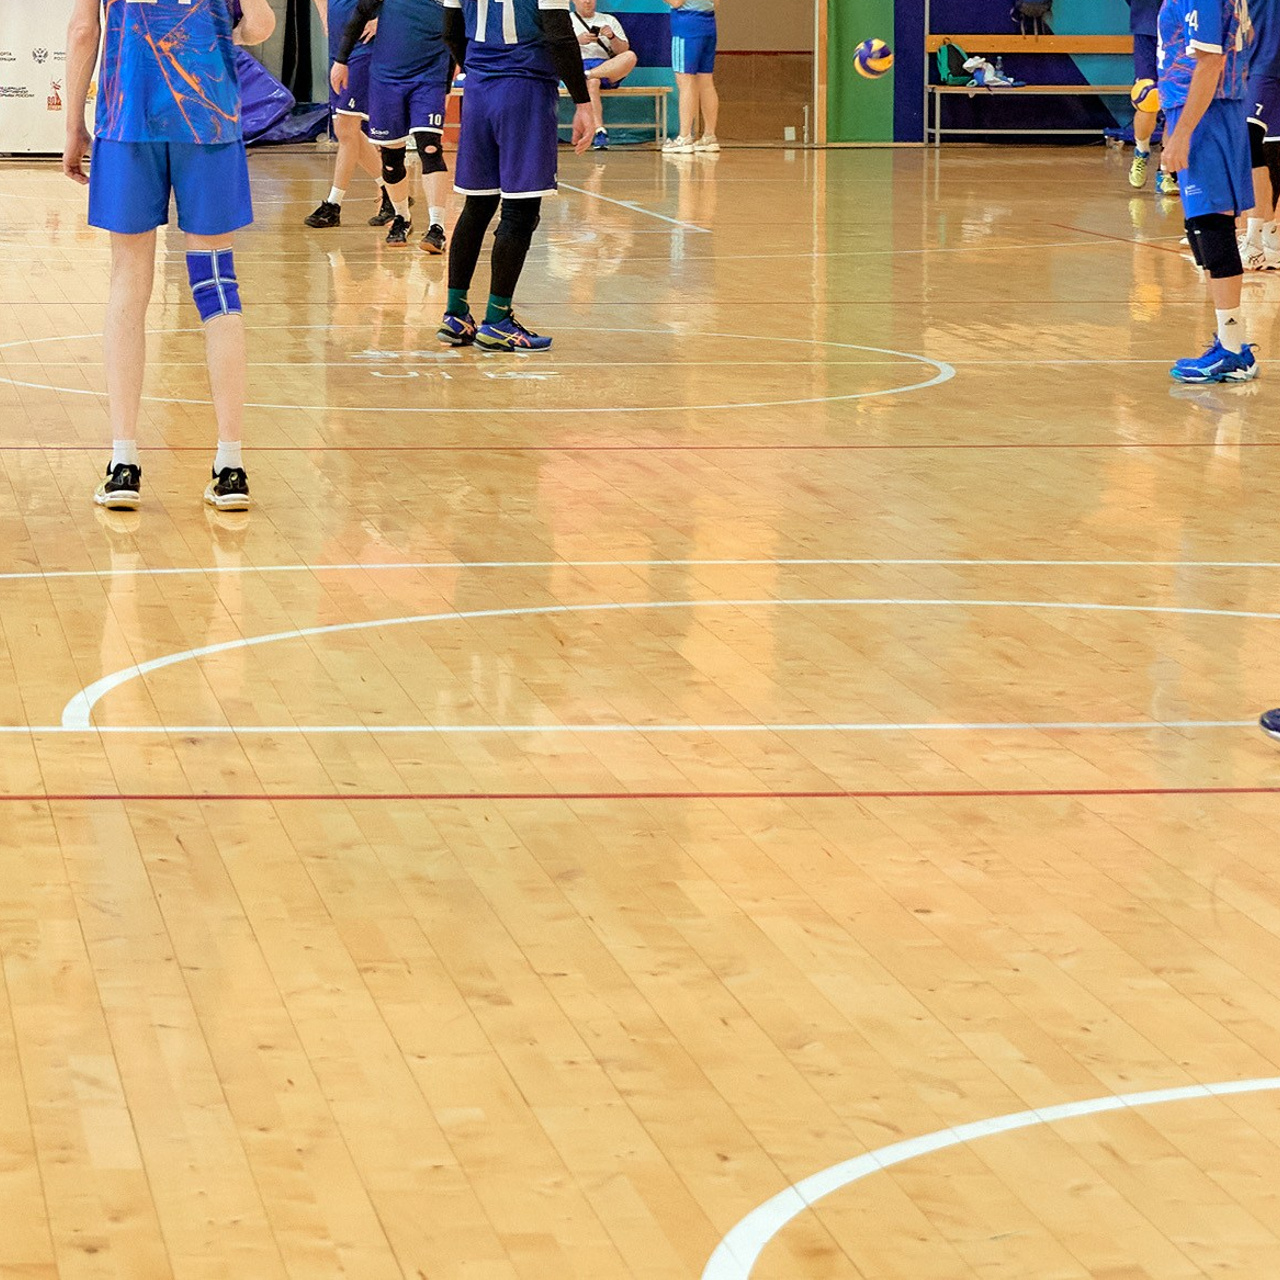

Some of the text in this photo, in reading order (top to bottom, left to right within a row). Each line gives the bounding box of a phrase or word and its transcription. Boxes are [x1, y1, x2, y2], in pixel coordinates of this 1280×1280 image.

[347, 97, 356, 109] 4
[1254, 103, 1264, 116] 7
[428, 113, 443, 126] 10
